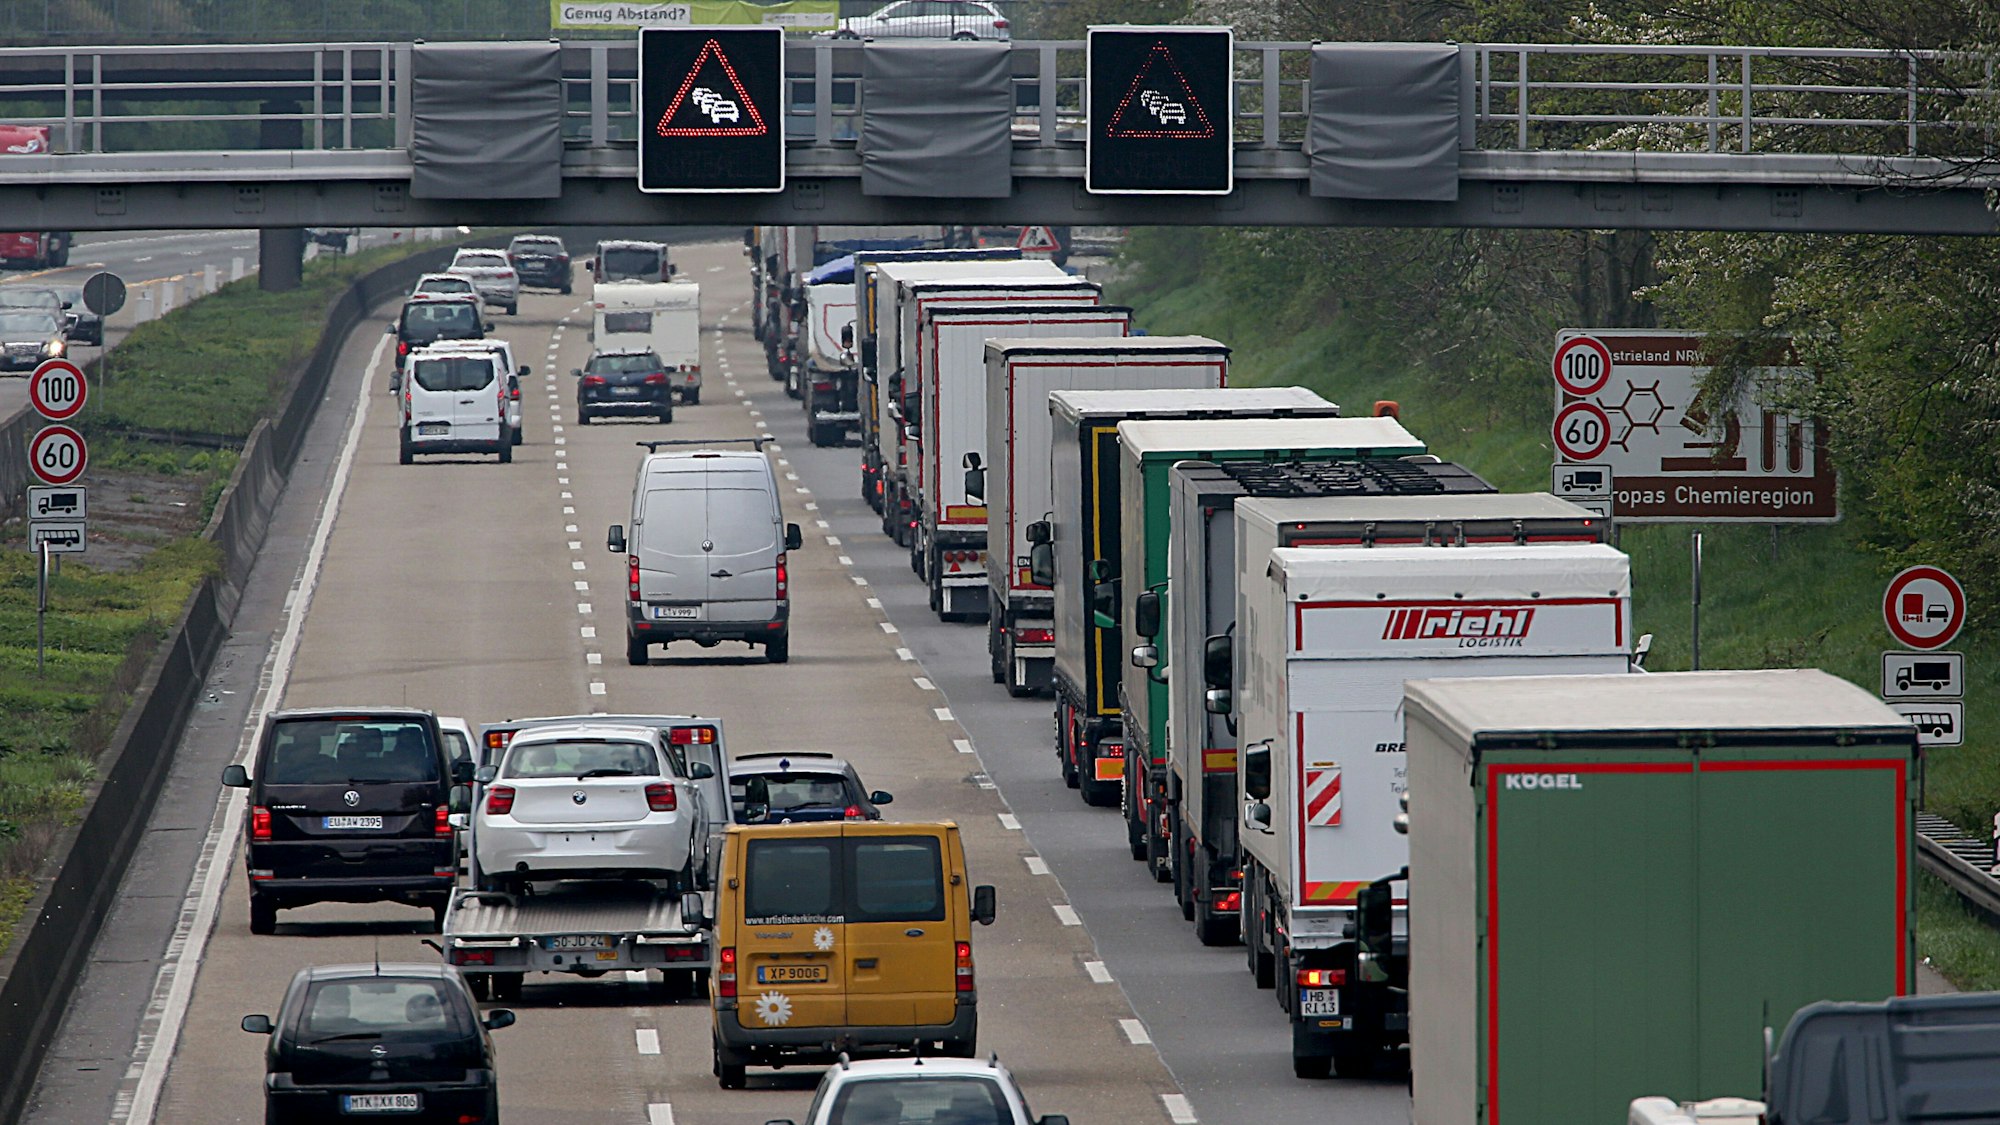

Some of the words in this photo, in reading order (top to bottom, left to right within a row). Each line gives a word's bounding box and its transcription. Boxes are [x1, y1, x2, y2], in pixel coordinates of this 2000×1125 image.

[565, 6, 613, 21] Genug
[617, 6, 686, 21] Abstand?
[1611, 350, 1670, 361] strieland
[1565, 353, 1599, 379] 100
[42, 377, 75, 403] 100
[1566, 419, 1599, 445] 60
[43, 443, 74, 469] 60
[1675, 486, 1814, 509] Chemieregion
[1423, 610, 1529, 637] riehl
[1458, 637, 1523, 648] LOGISTIK
[1375, 742, 1407, 752] BRE
[1506, 773, 1582, 789] KÖGEL
[329, 817, 341, 827] EU
[360, 817, 381, 827] 2395
[771, 968, 786, 979] XP
[789, 967, 820, 979] 9006
[1309, 991, 1324, 1002] HB
[1304, 1003, 1319, 1014] RI
[1321, 1002, 1336, 1014] 13
